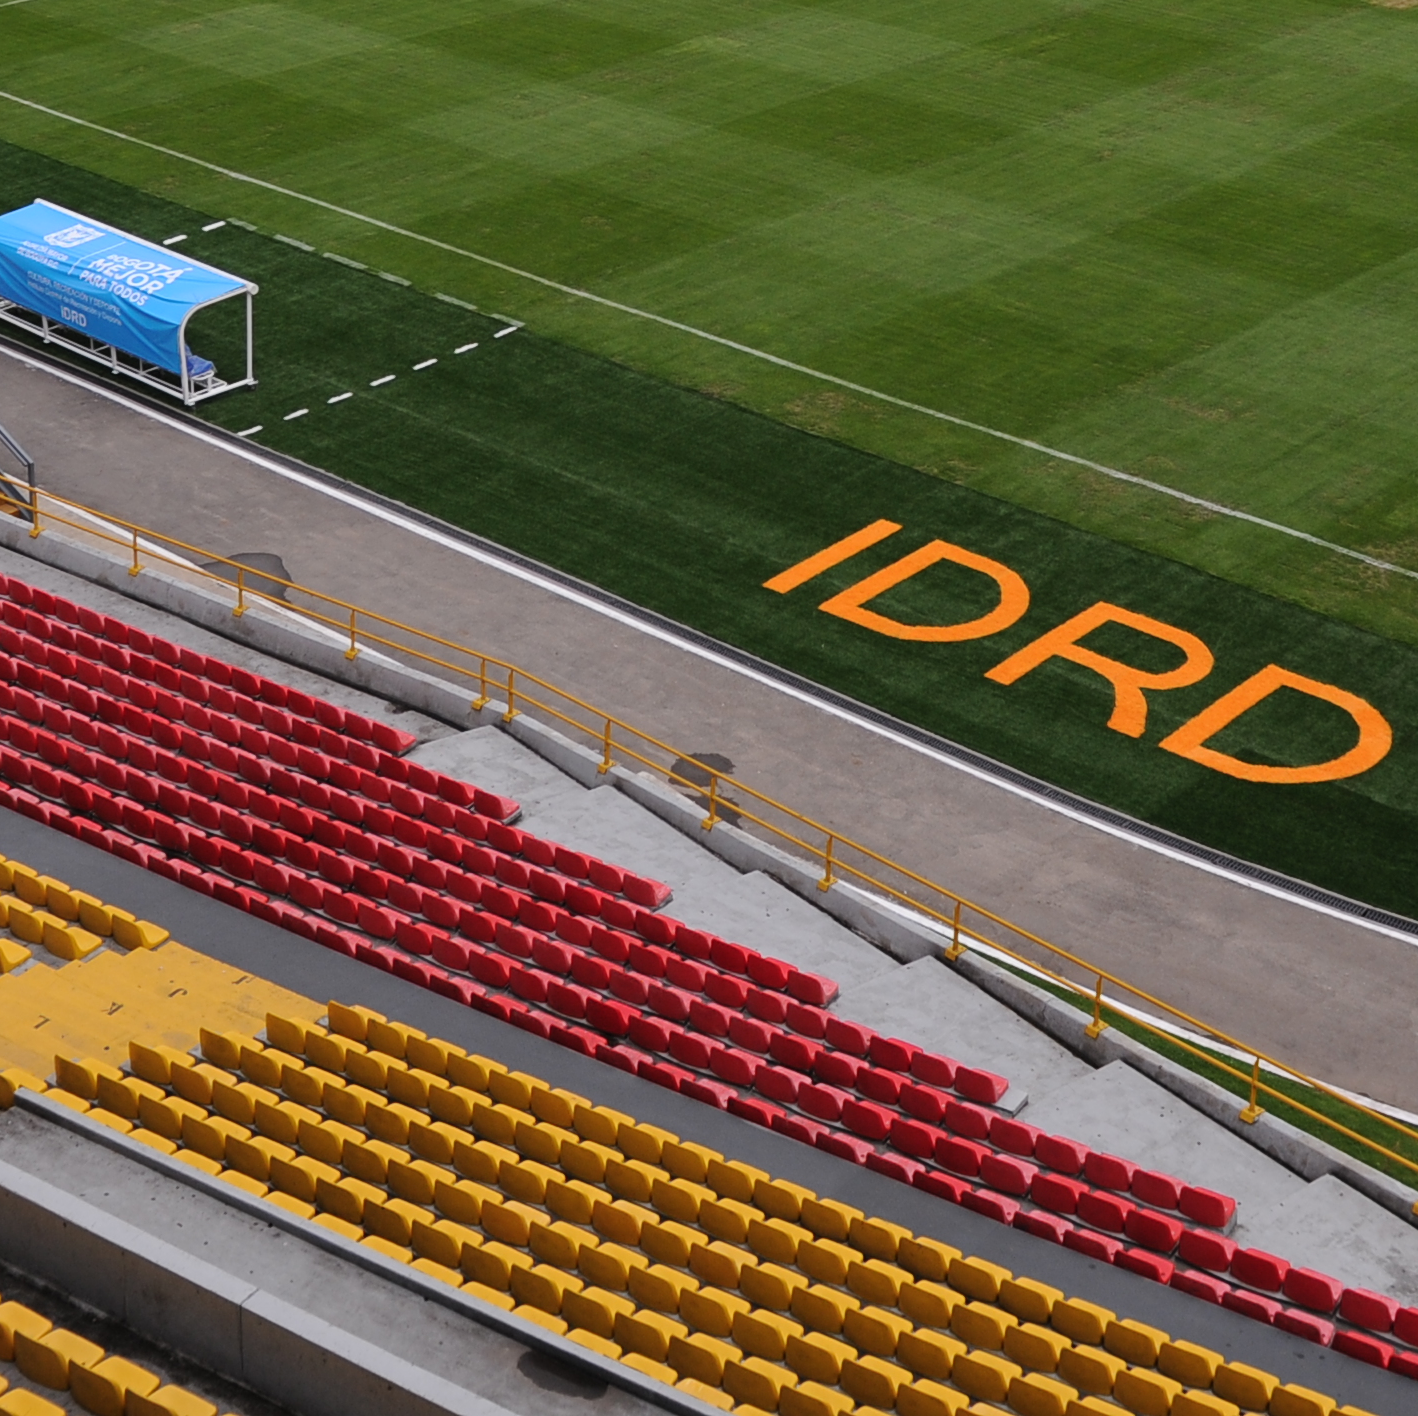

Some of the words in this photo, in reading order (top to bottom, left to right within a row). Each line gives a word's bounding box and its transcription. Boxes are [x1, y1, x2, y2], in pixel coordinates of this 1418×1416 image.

[88, 258, 164, 294] MEJOR
[107, 254, 193, 284] BOGOTÁ
[79, 270, 108, 290] PARA
[108, 281, 148, 306] TODOS
[61, 305, 87, 327] IDRD
[761, 518, 1393, 784] IDRD
